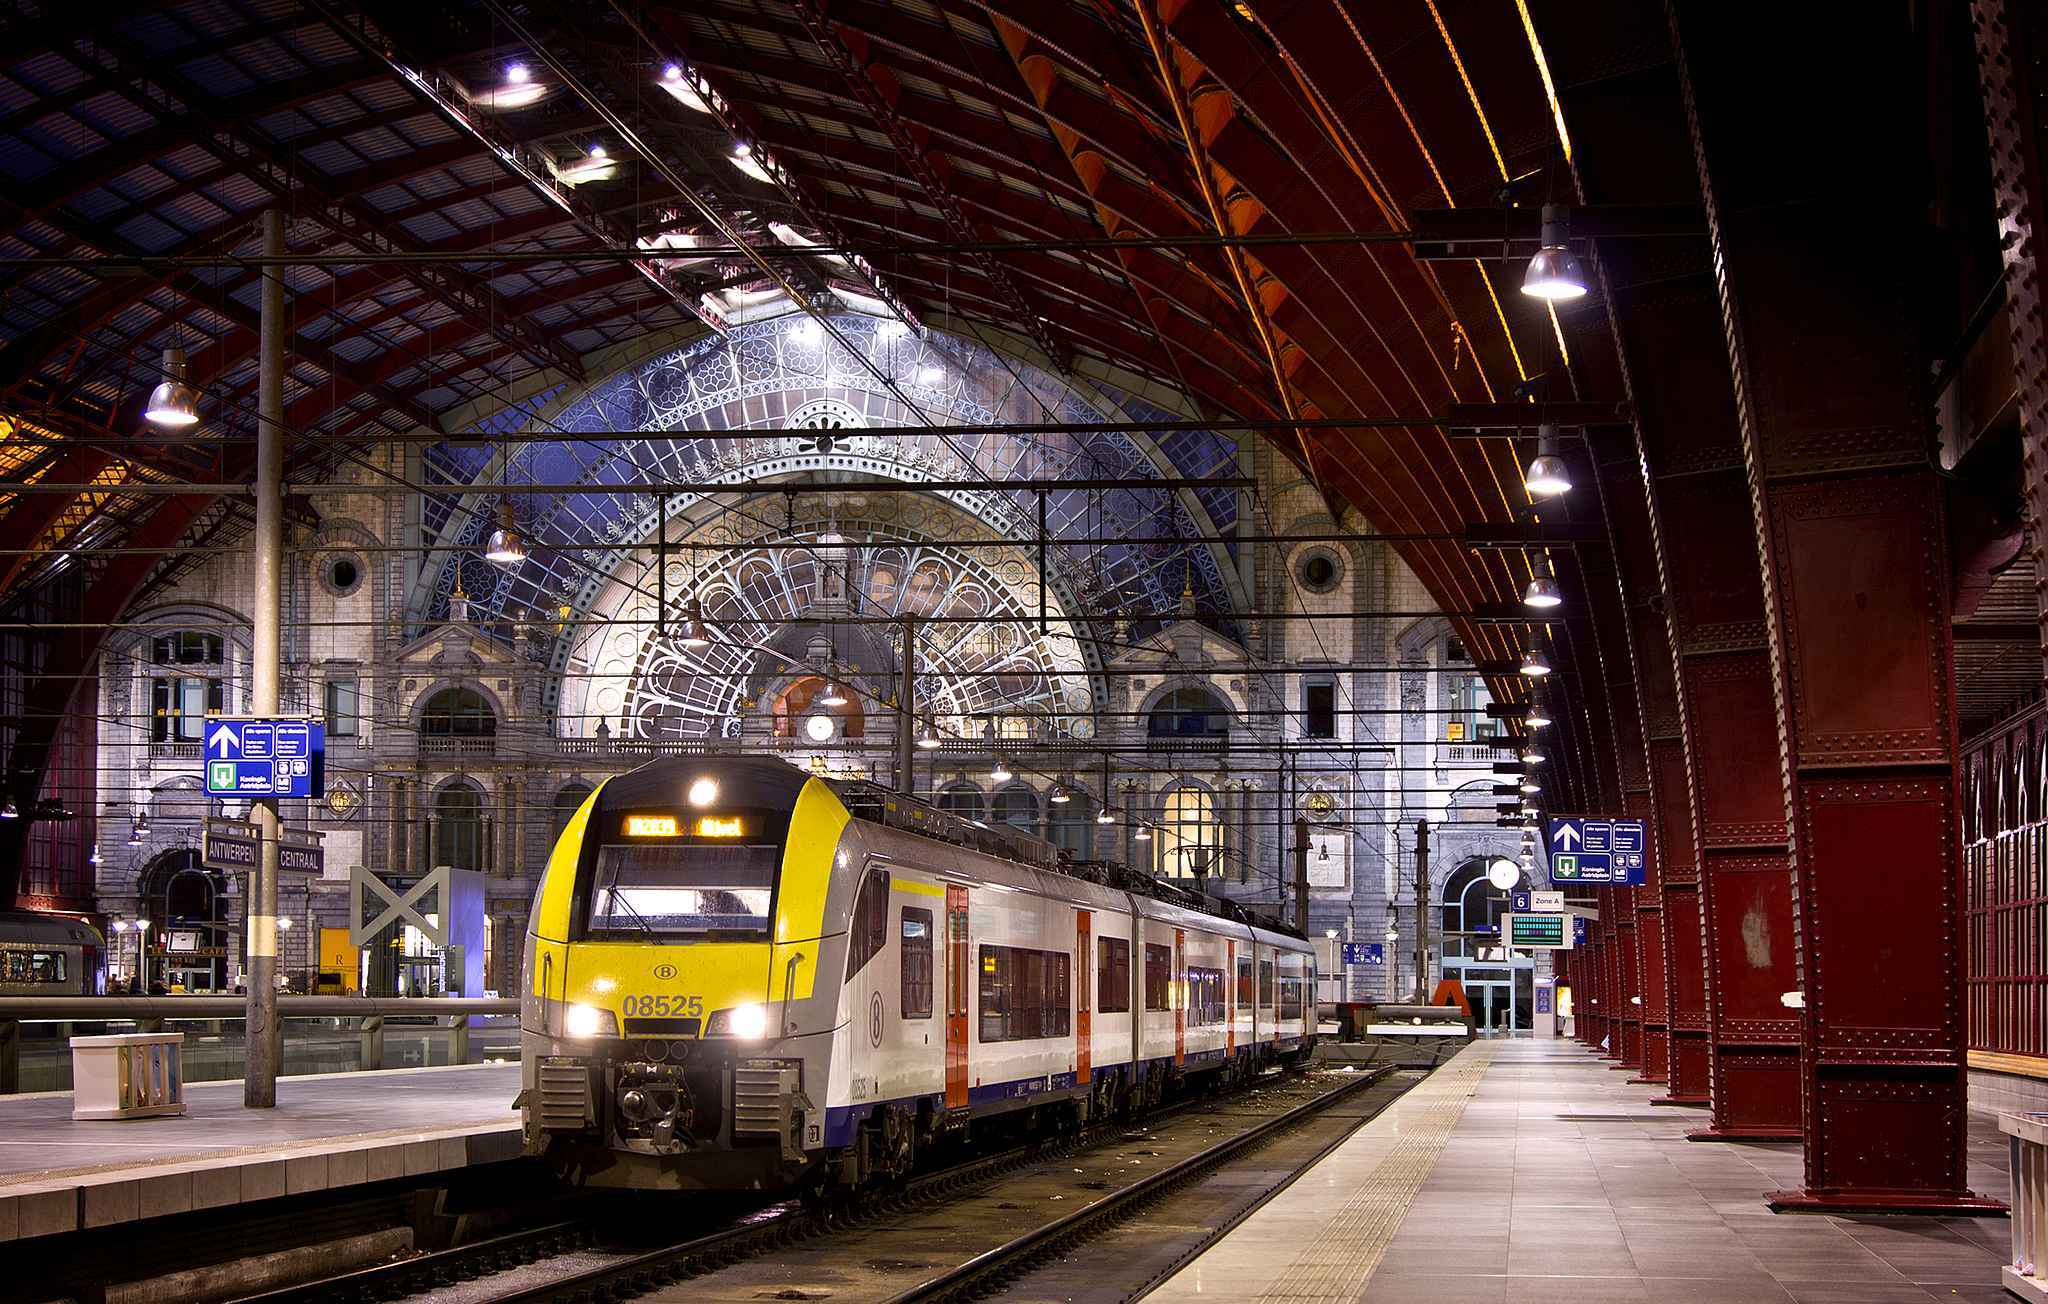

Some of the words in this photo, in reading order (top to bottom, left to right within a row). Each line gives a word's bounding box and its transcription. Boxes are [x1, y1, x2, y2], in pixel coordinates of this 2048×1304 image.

[208, 841, 256, 862] ANTWERPEN
[280, 850, 319, 870] CENTRAAL
[1517, 897, 1525, 907] 6
[336, 954, 344, 965] R
[660, 966, 671, 977] B
[623, 994, 704, 1017] 08525
